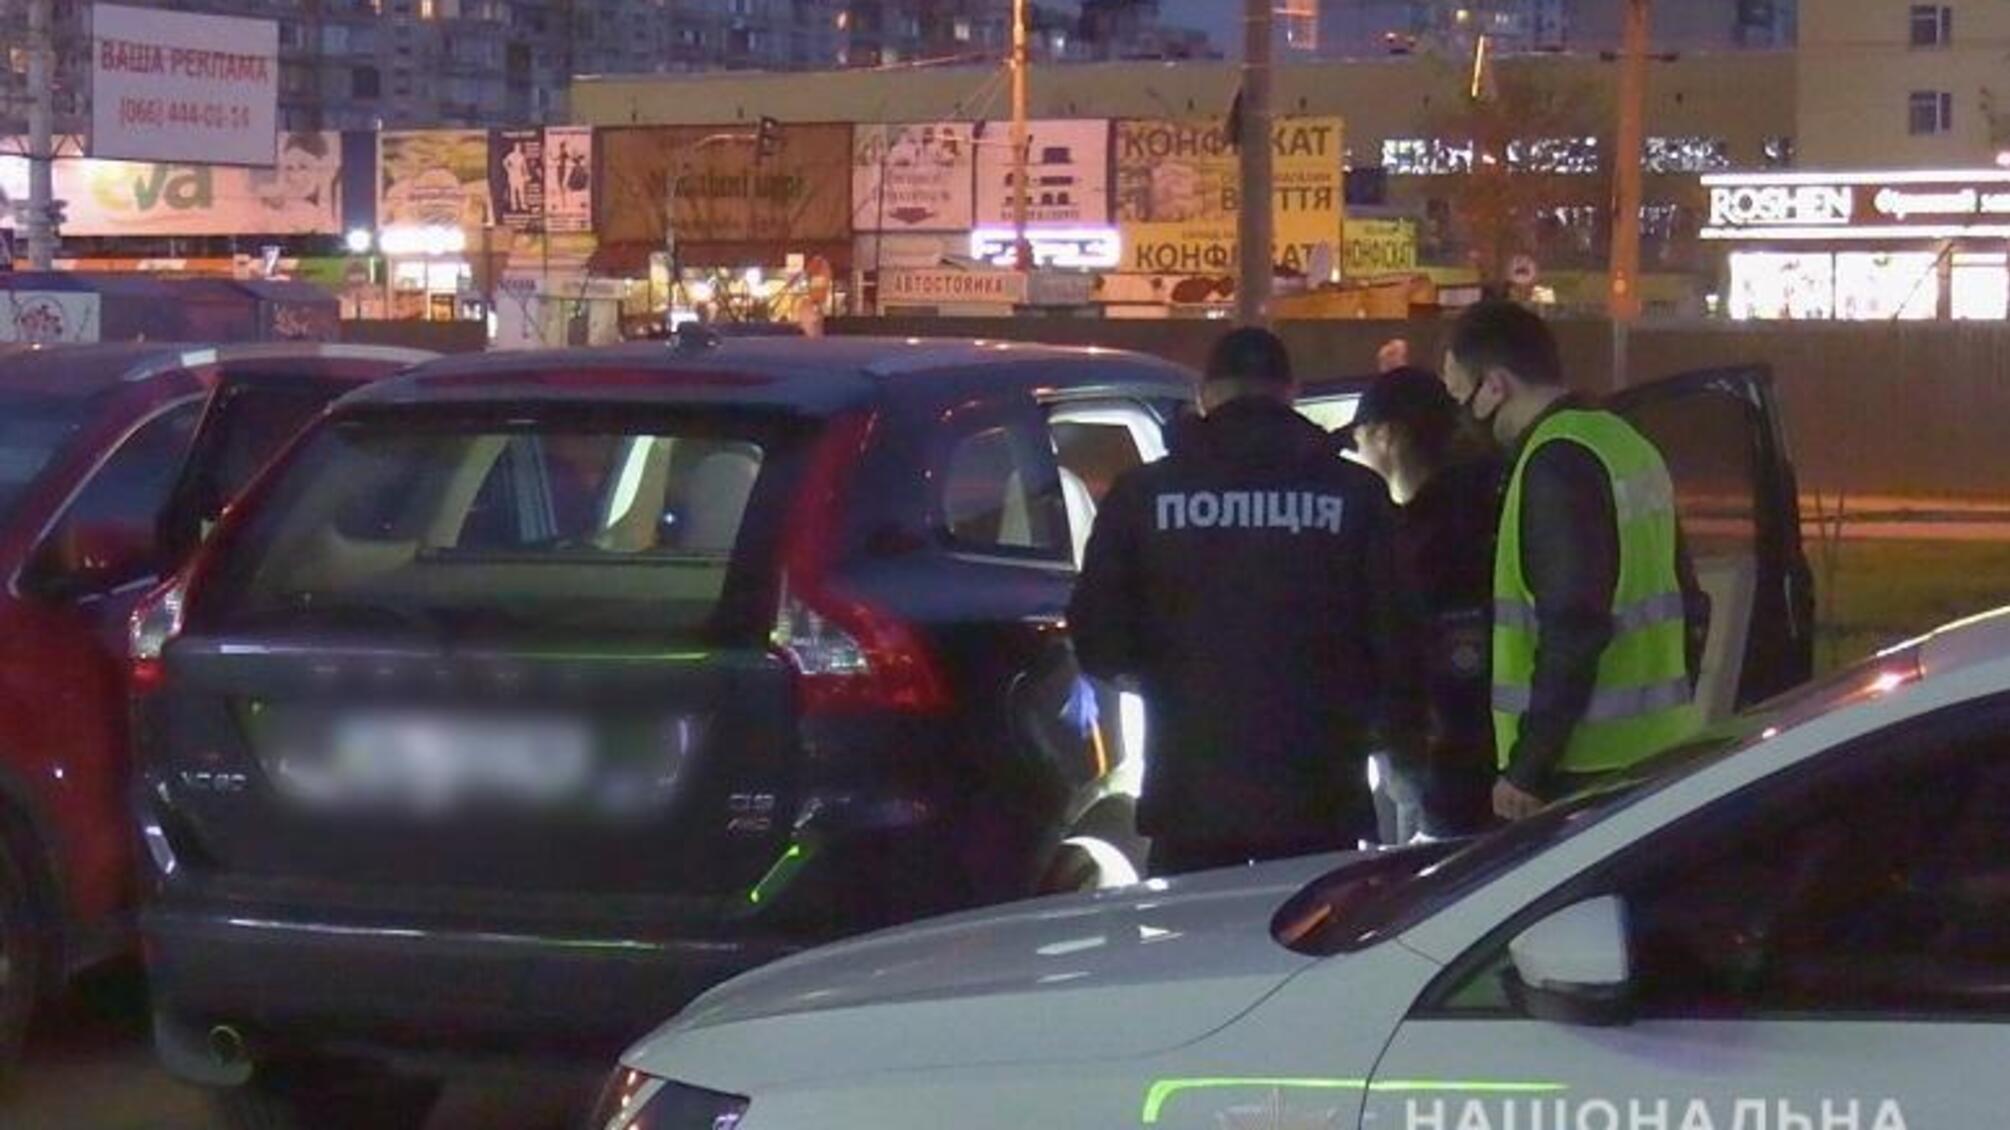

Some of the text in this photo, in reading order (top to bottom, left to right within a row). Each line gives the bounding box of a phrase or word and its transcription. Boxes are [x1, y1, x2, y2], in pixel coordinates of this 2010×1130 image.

[101, 39, 268, 83] ВАША РЕКЛАМА
[1709, 186, 1851, 224] ROSHEN
[894, 276, 1003, 295] АВТОСТОЯНКА
[1157, 491, 1344, 535] ПОЛІЦІЯ
